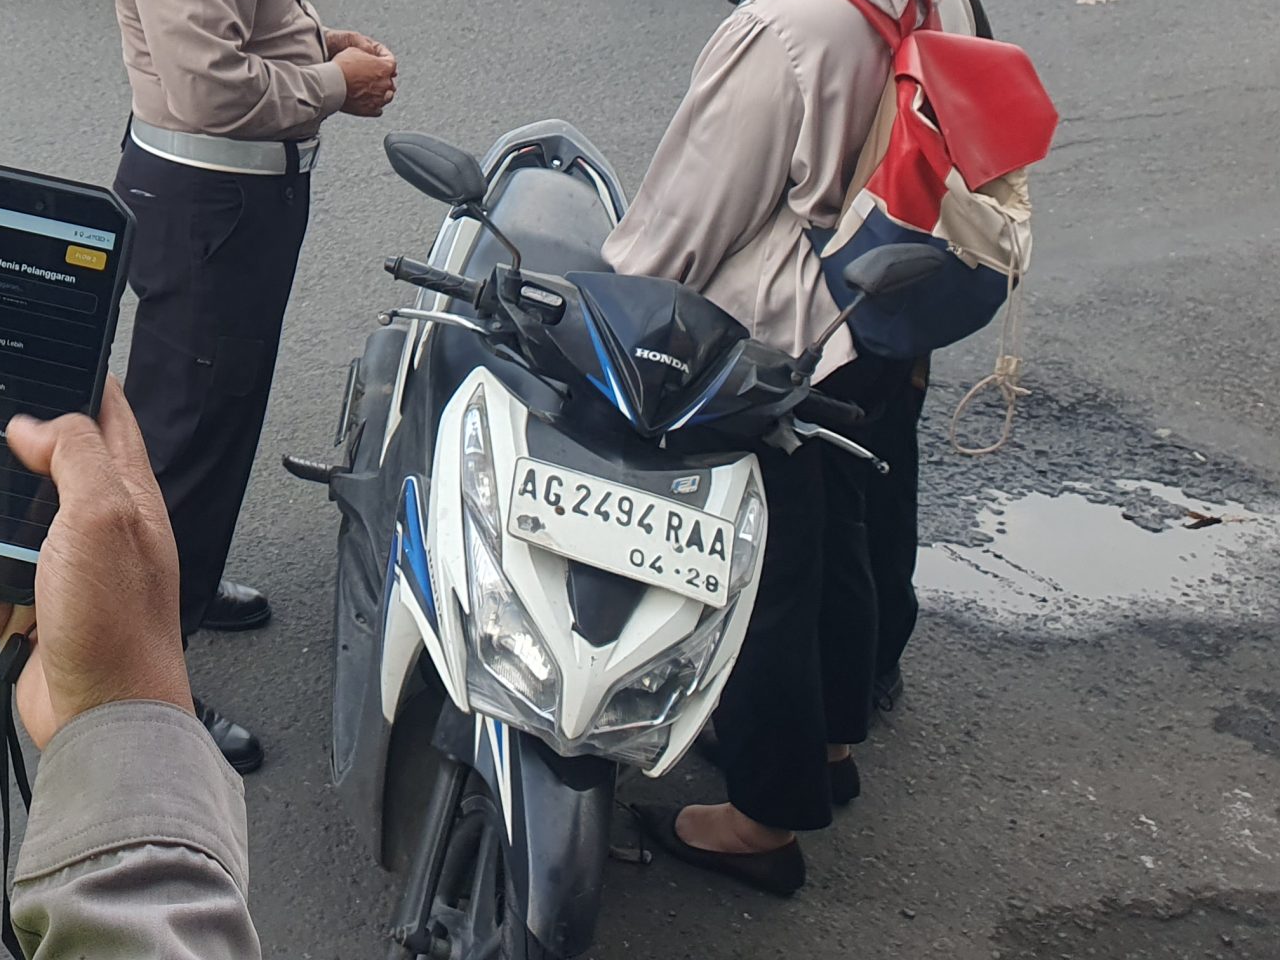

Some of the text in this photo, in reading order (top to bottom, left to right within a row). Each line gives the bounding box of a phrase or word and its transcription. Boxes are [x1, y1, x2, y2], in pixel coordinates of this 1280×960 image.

[21, 264, 76, 284] Pelanggaran
[7, 339, 24, 349] Lebih
[635, 347, 690, 374] HONDA
[518, 468, 726, 562] AG 2494 RAA
